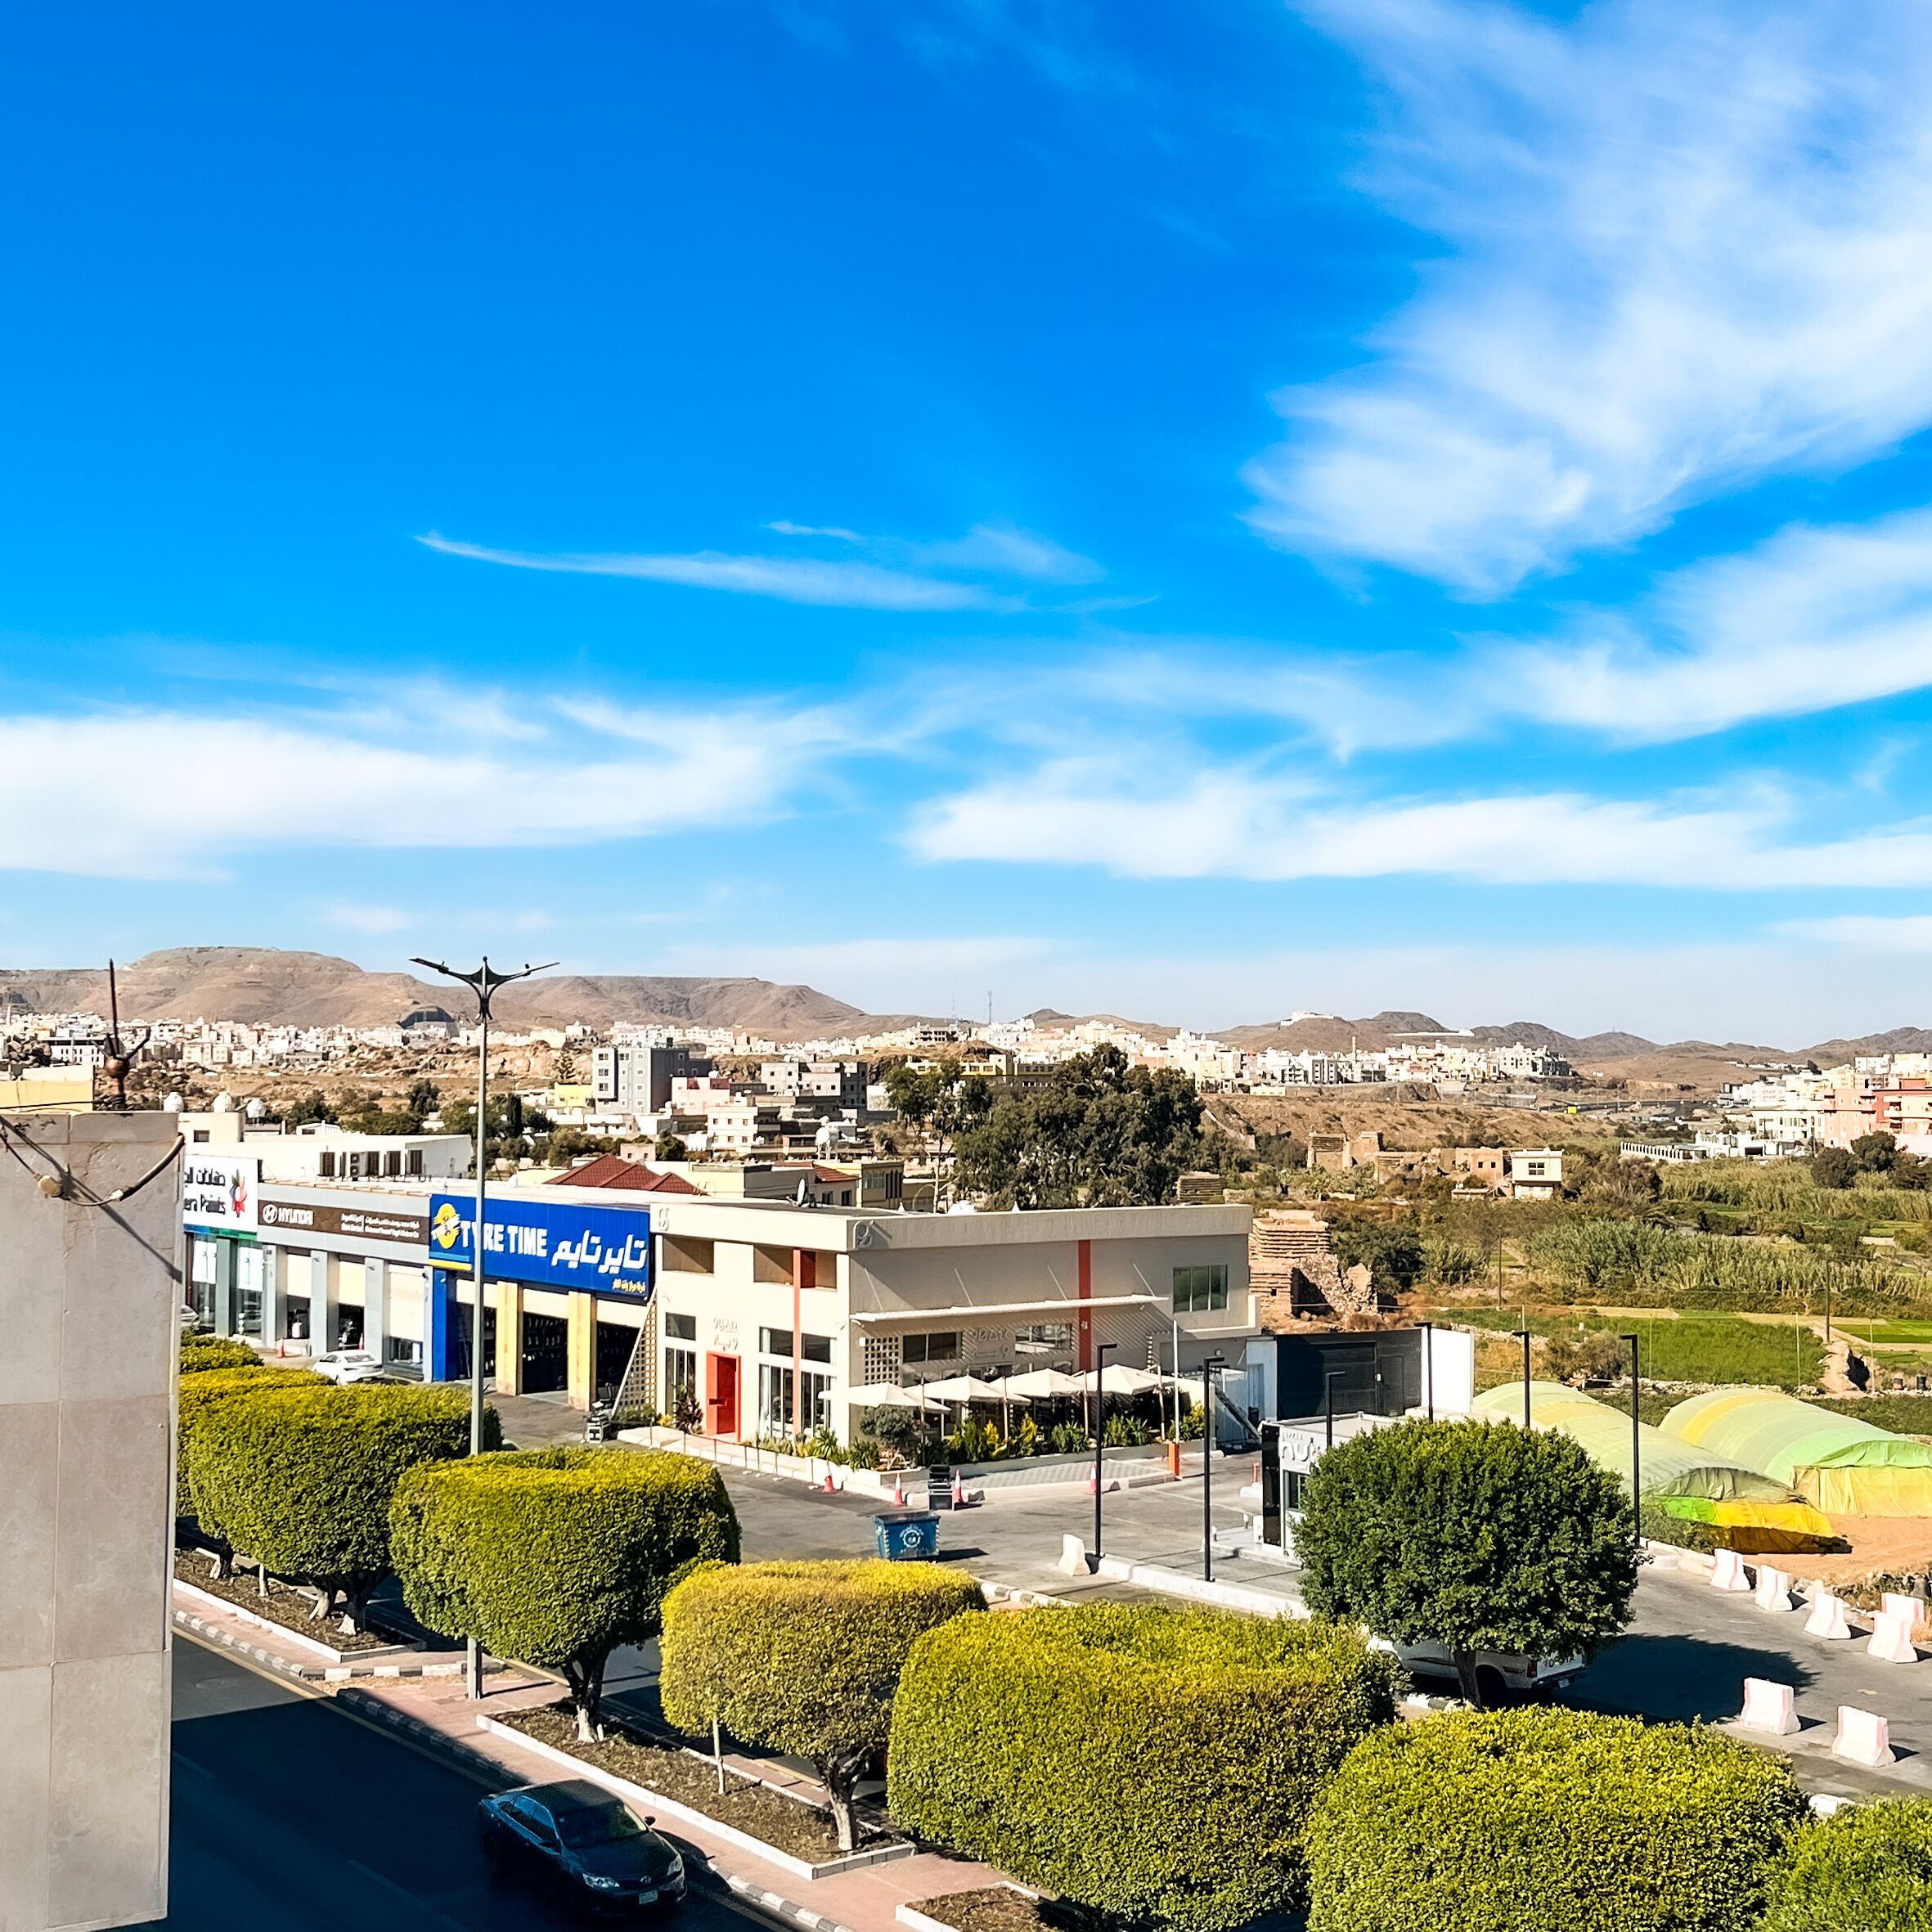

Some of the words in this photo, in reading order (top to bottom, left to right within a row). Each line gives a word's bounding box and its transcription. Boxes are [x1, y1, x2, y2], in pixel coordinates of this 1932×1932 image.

[507, 1225, 547, 1256] TIME
[551, 1229, 601, 1269] تايم
[598, 1234, 647, 1274] تاير
